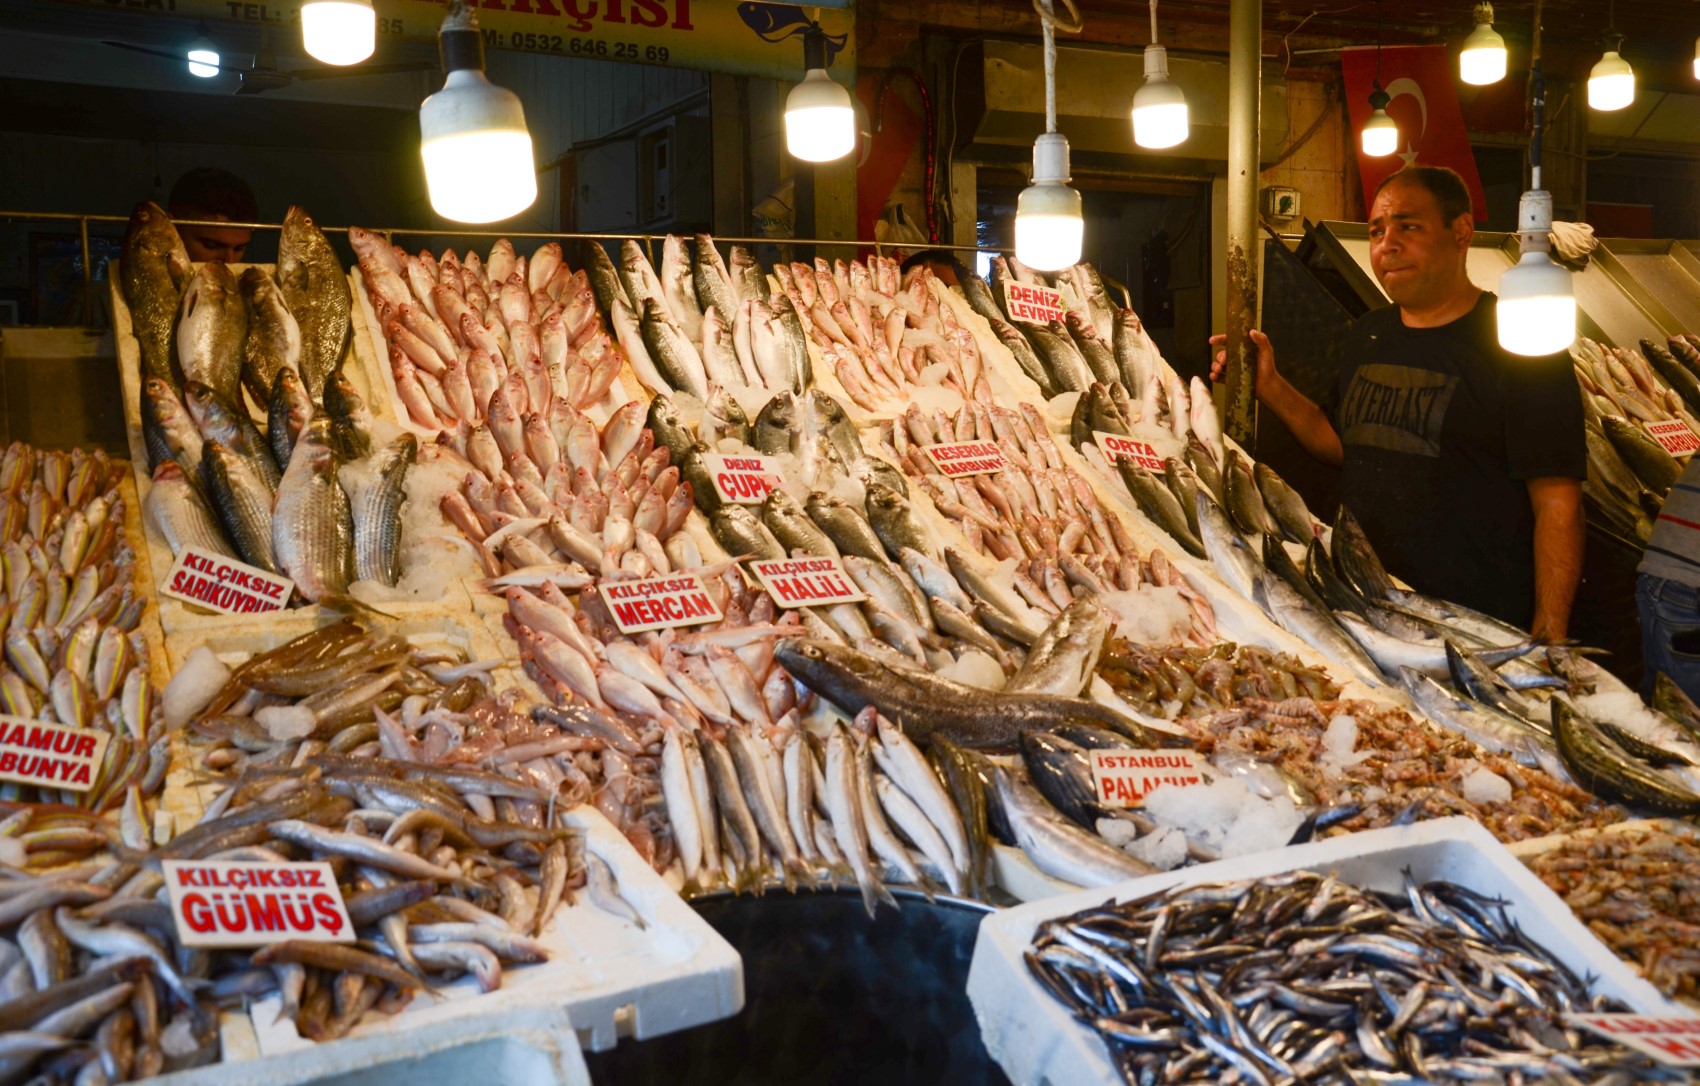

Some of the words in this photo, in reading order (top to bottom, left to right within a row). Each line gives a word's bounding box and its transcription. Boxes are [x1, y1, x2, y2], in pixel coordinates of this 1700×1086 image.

[227, 1, 281, 22] TEL:
[511, 31, 563, 51] 0532
[570, 37, 607, 56] 646
[614, 41, 639, 59] 25
[646, 45, 670, 62] 69
[1344, 374, 1446, 440] EVERLAST
[1105, 436, 1159, 458] ORTA
[182, 551, 285, 600] KILÇIKSIZ
[757, 560, 838, 577] KILÇIKSIZ
[606, 577, 699, 599] KILÇIKSIZ
[612, 592, 717, 627] MERCAN
[0, 751, 91, 785] BUNYA
[176, 867, 326, 891] KILÇIKSIZ
[181, 892, 344, 936] GÜMÜŞ
